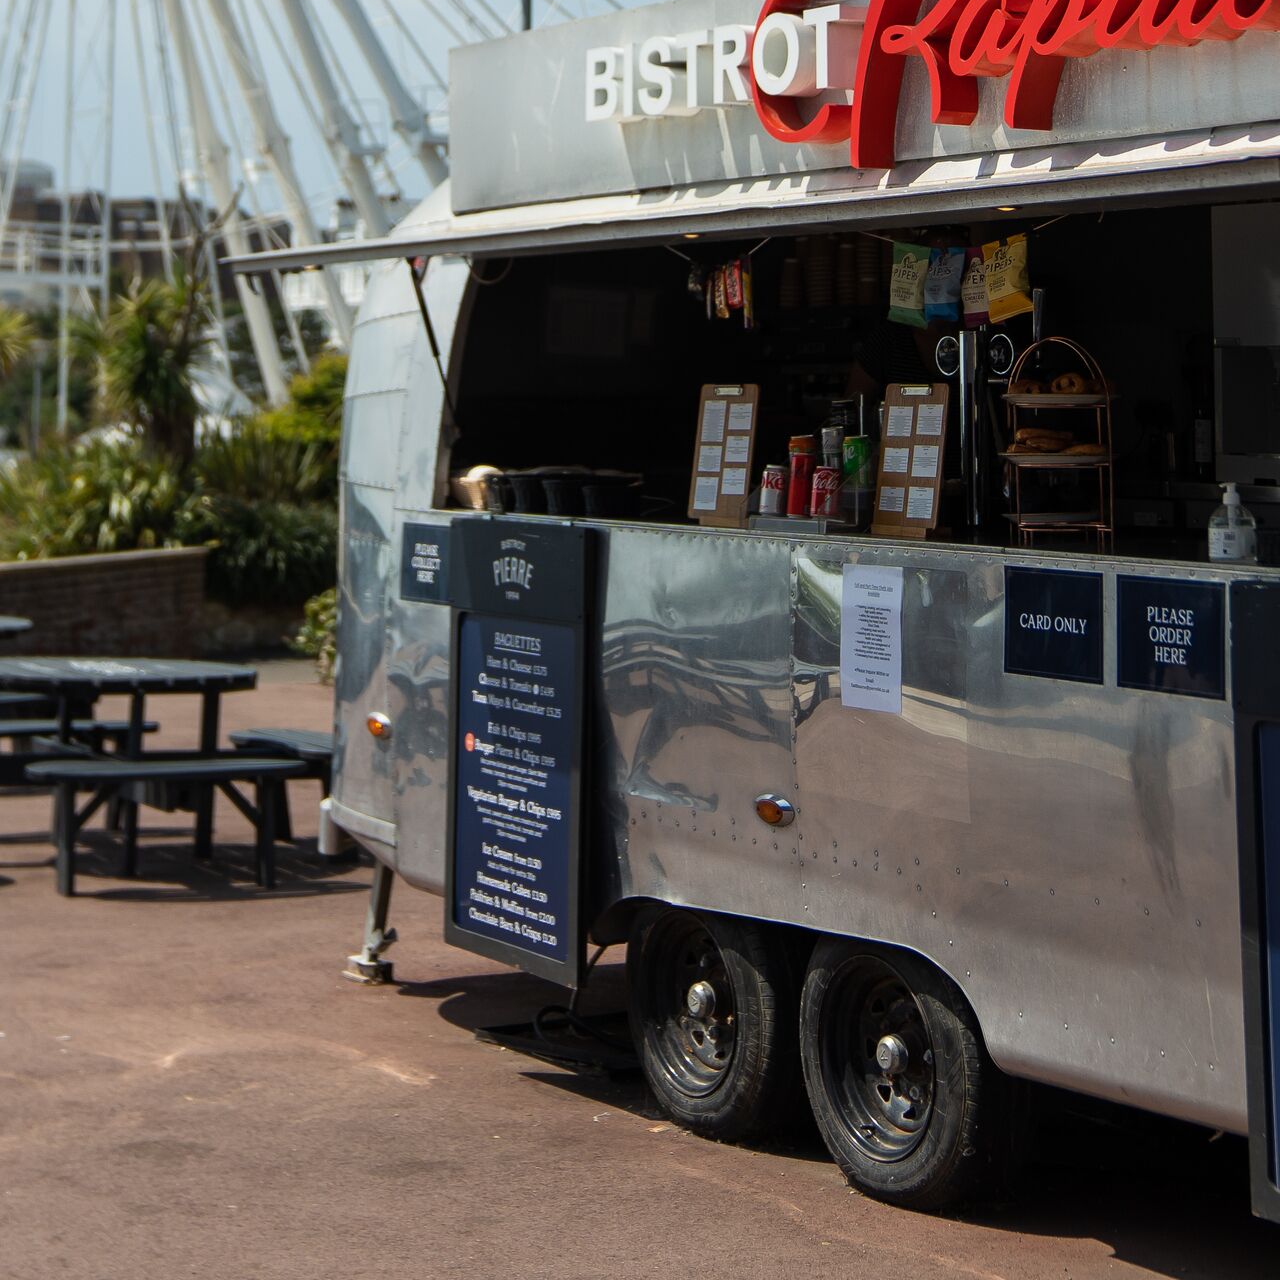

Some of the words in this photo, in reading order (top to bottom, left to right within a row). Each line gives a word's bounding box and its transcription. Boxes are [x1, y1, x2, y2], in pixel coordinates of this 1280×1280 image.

[585, 4, 841, 121] BISTROT
[893, 268, 919, 280] PIPERS
[985, 258, 1013, 273] PIPERS
[493, 556, 534, 589] PIERRE
[1020, 613, 1052, 630] CARD
[1054, 616, 1087, 635] ONLY
[1147, 606, 1194, 627] PLEASE
[494, 632, 542, 651] BAGUETTES
[1148, 626, 1192, 646] ORDER
[501, 658, 509, 669] &
[509, 659, 532, 673] Cheese
[1154, 646, 1187, 665] HERE
[478, 672, 501, 687] Cheese
[501, 676, 508, 689] &
[508, 678, 532, 693] Tomato
[472, 690, 488, 704] Tuna
[488, 694, 504, 708] Mayo
[504, 697, 512, 709] &
[512, 698, 545, 715] Cucumber
[488, 722, 501, 734] Fish
[501, 725, 508, 737] &
[508, 726, 527, 743] Chips
[474, 738, 495, 756] Burger
[495, 743, 514, 758] Pierre
[514, 747, 521, 759] &
[521, 749, 541, 767] Chips
[467, 785, 498, 803] Vegetarian
[498, 793, 519, 812] Burger
[519, 799, 526, 811] &
[526, 801, 546, 819] Chips
[482, 841, 492, 855] Ice
[492, 845, 513, 861] Cream
[477, 871, 511, 892] Homemade
[511, 882, 532, 899] Cakes
[494, 896, 501, 908] &
[501, 898, 525, 916] Muffins
[469, 907, 499, 927] Chocolate
[498, 916, 514, 932] Bars
[514, 921, 521, 934] &
[521, 924, 541, 943] Crisps
